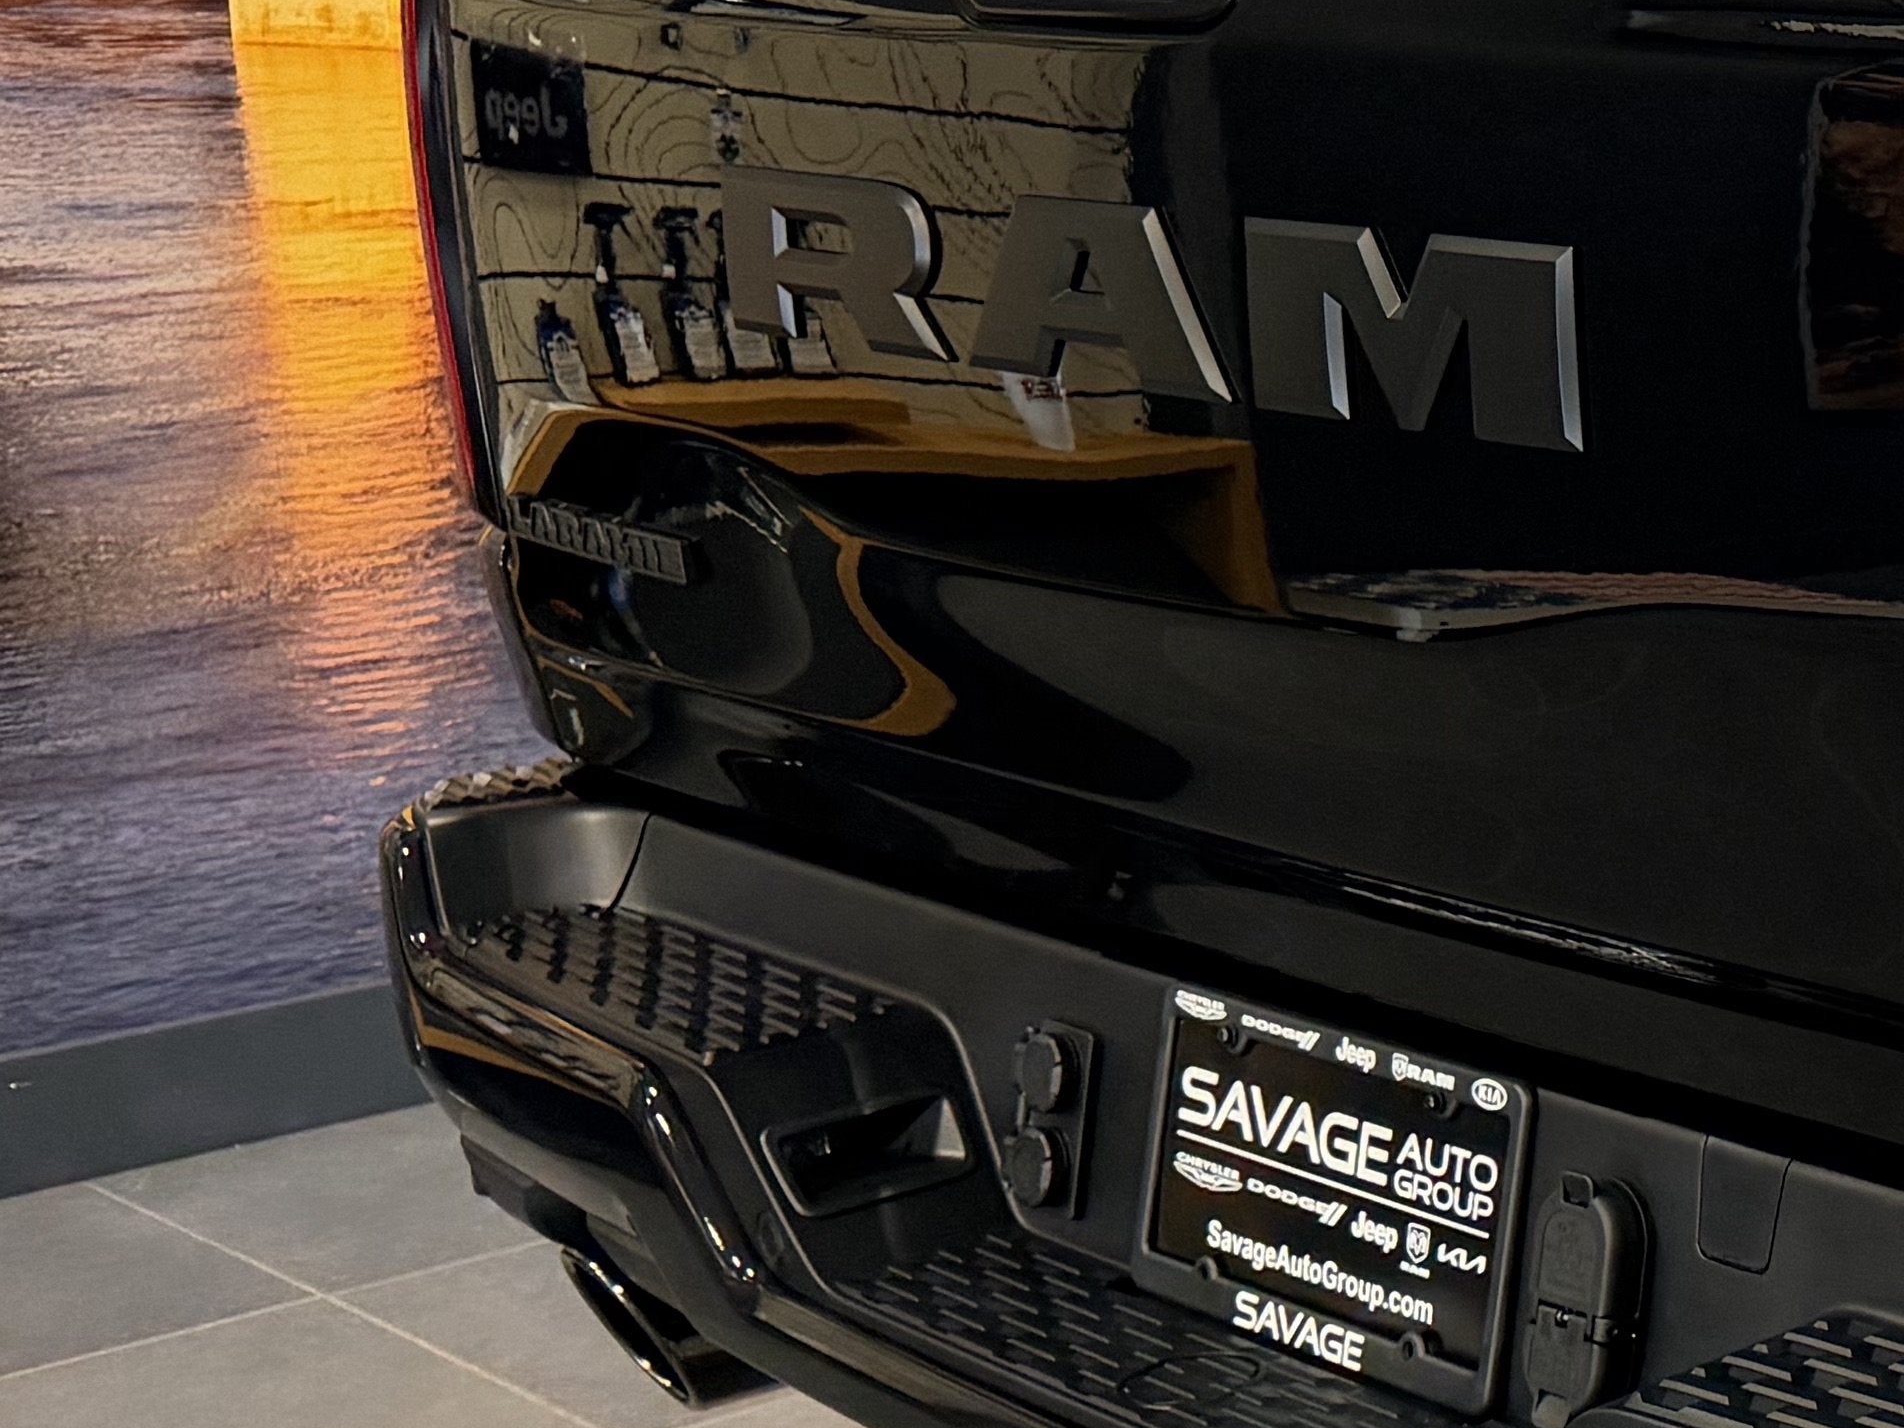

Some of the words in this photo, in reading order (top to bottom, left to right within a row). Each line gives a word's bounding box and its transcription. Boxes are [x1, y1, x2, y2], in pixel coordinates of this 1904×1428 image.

[720, 166, 1583, 452] RAM
[1241, 1013, 1309, 1045] DODGE
[1335, 1037, 1377, 1074] Jeep
[1406, 1062, 1456, 1092] RAM
[1176, 1066, 1393, 1188] SAVAGE
[1396, 1133, 1498, 1192] AUTO
[1176, 1151, 1240, 1180] CHRYSLER
[1247, 1177, 1332, 1217] DODGE
[1351, 1211, 1398, 1254] Jeep
[1393, 1169, 1495, 1222] GROUP
[1206, 1219, 1434, 1326] SavageAutoGroup.com
[1232, 1290, 1366, 1372] SAVAGE
